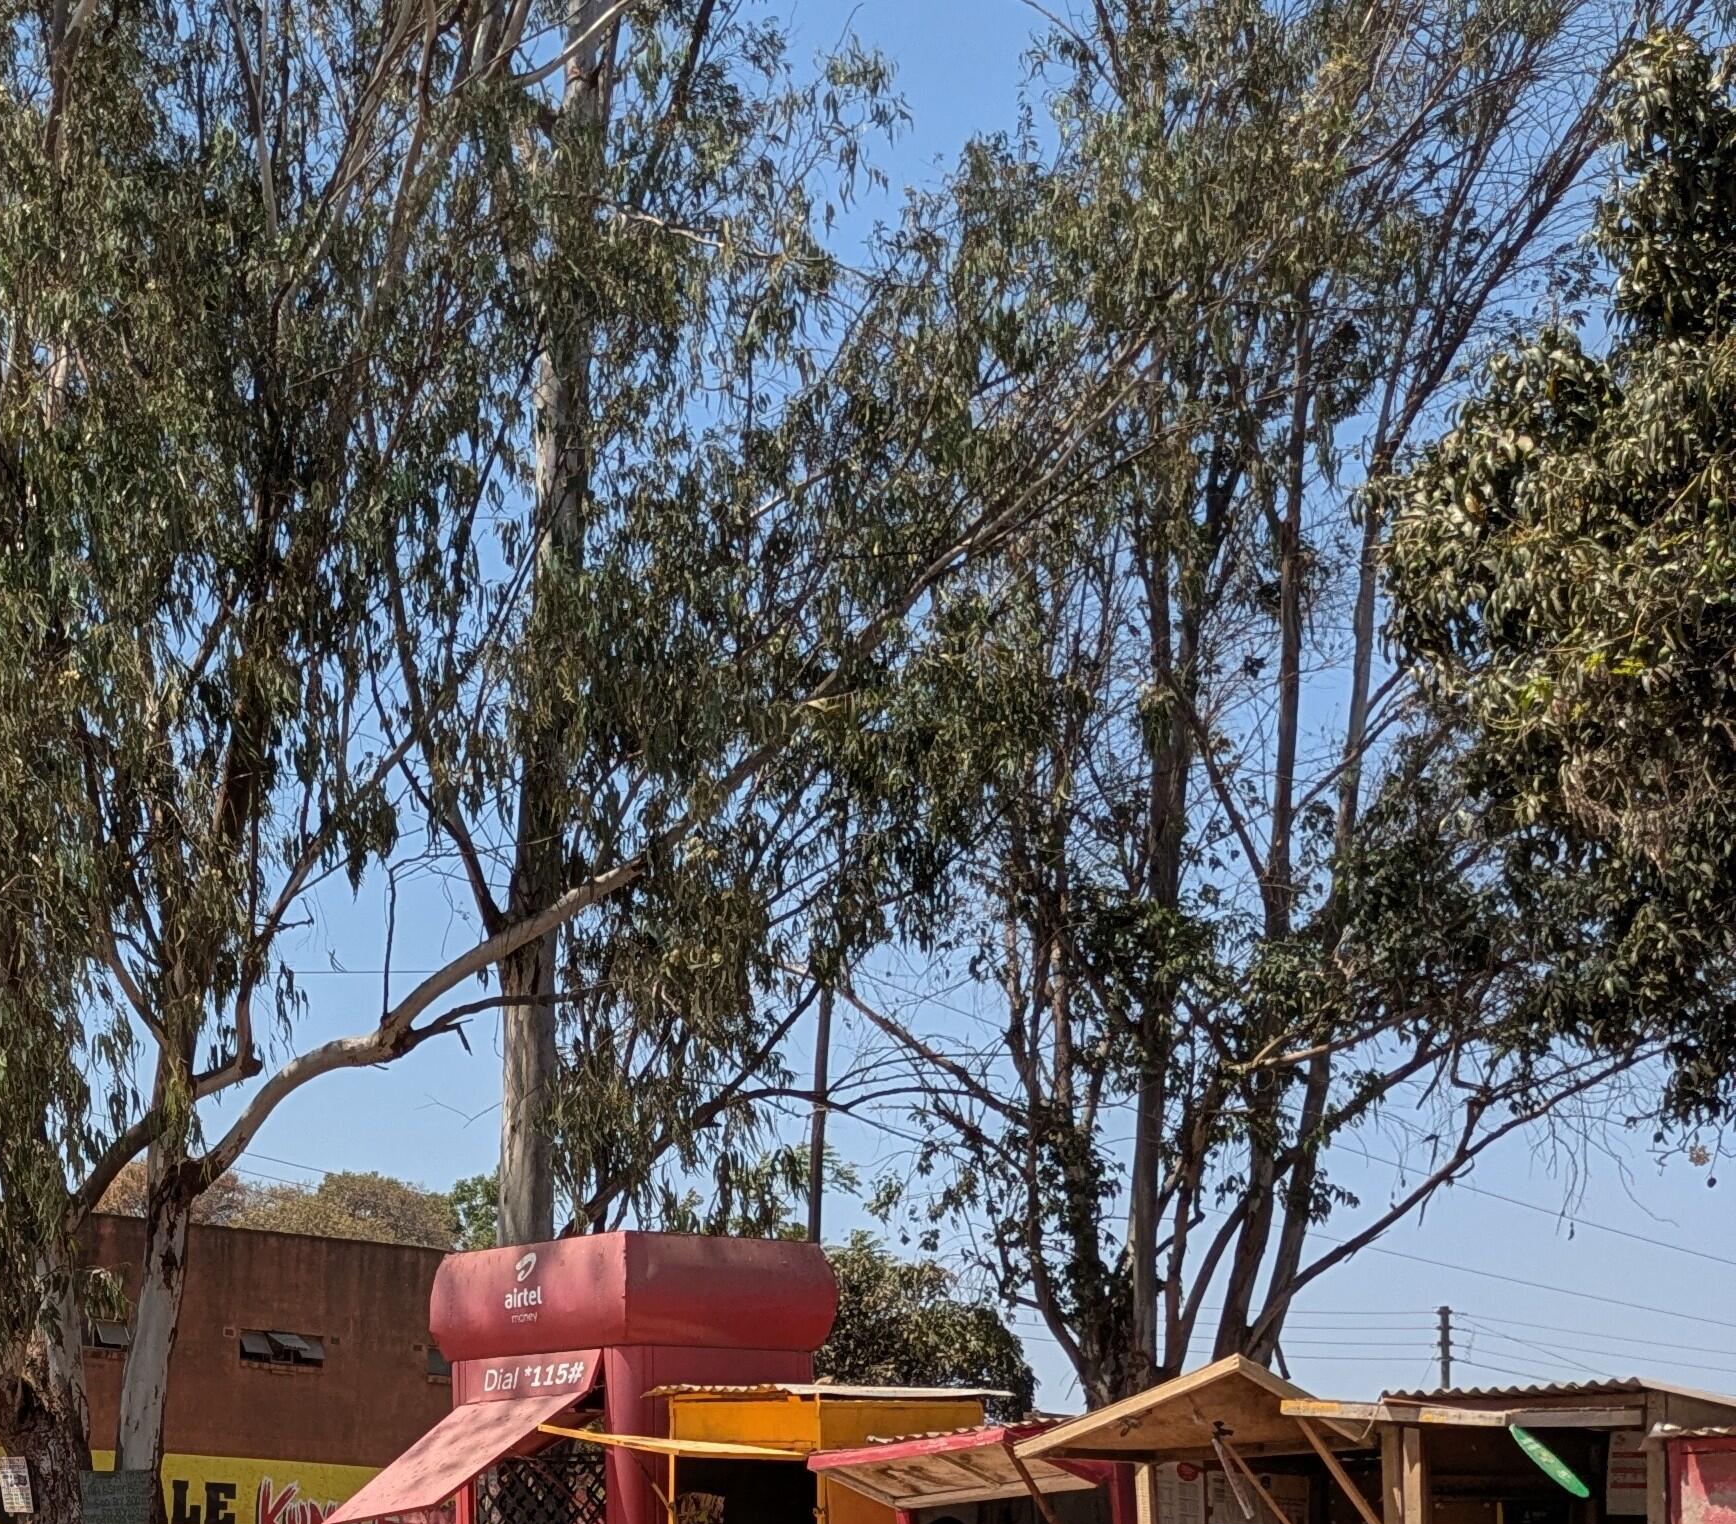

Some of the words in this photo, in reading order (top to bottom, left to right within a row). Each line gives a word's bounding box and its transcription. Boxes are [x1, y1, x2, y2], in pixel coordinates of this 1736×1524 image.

[504, 1286, 542, 1309] airtel
[511, 1312, 538, 1323] money
[484, 1367, 519, 1392] Dial
